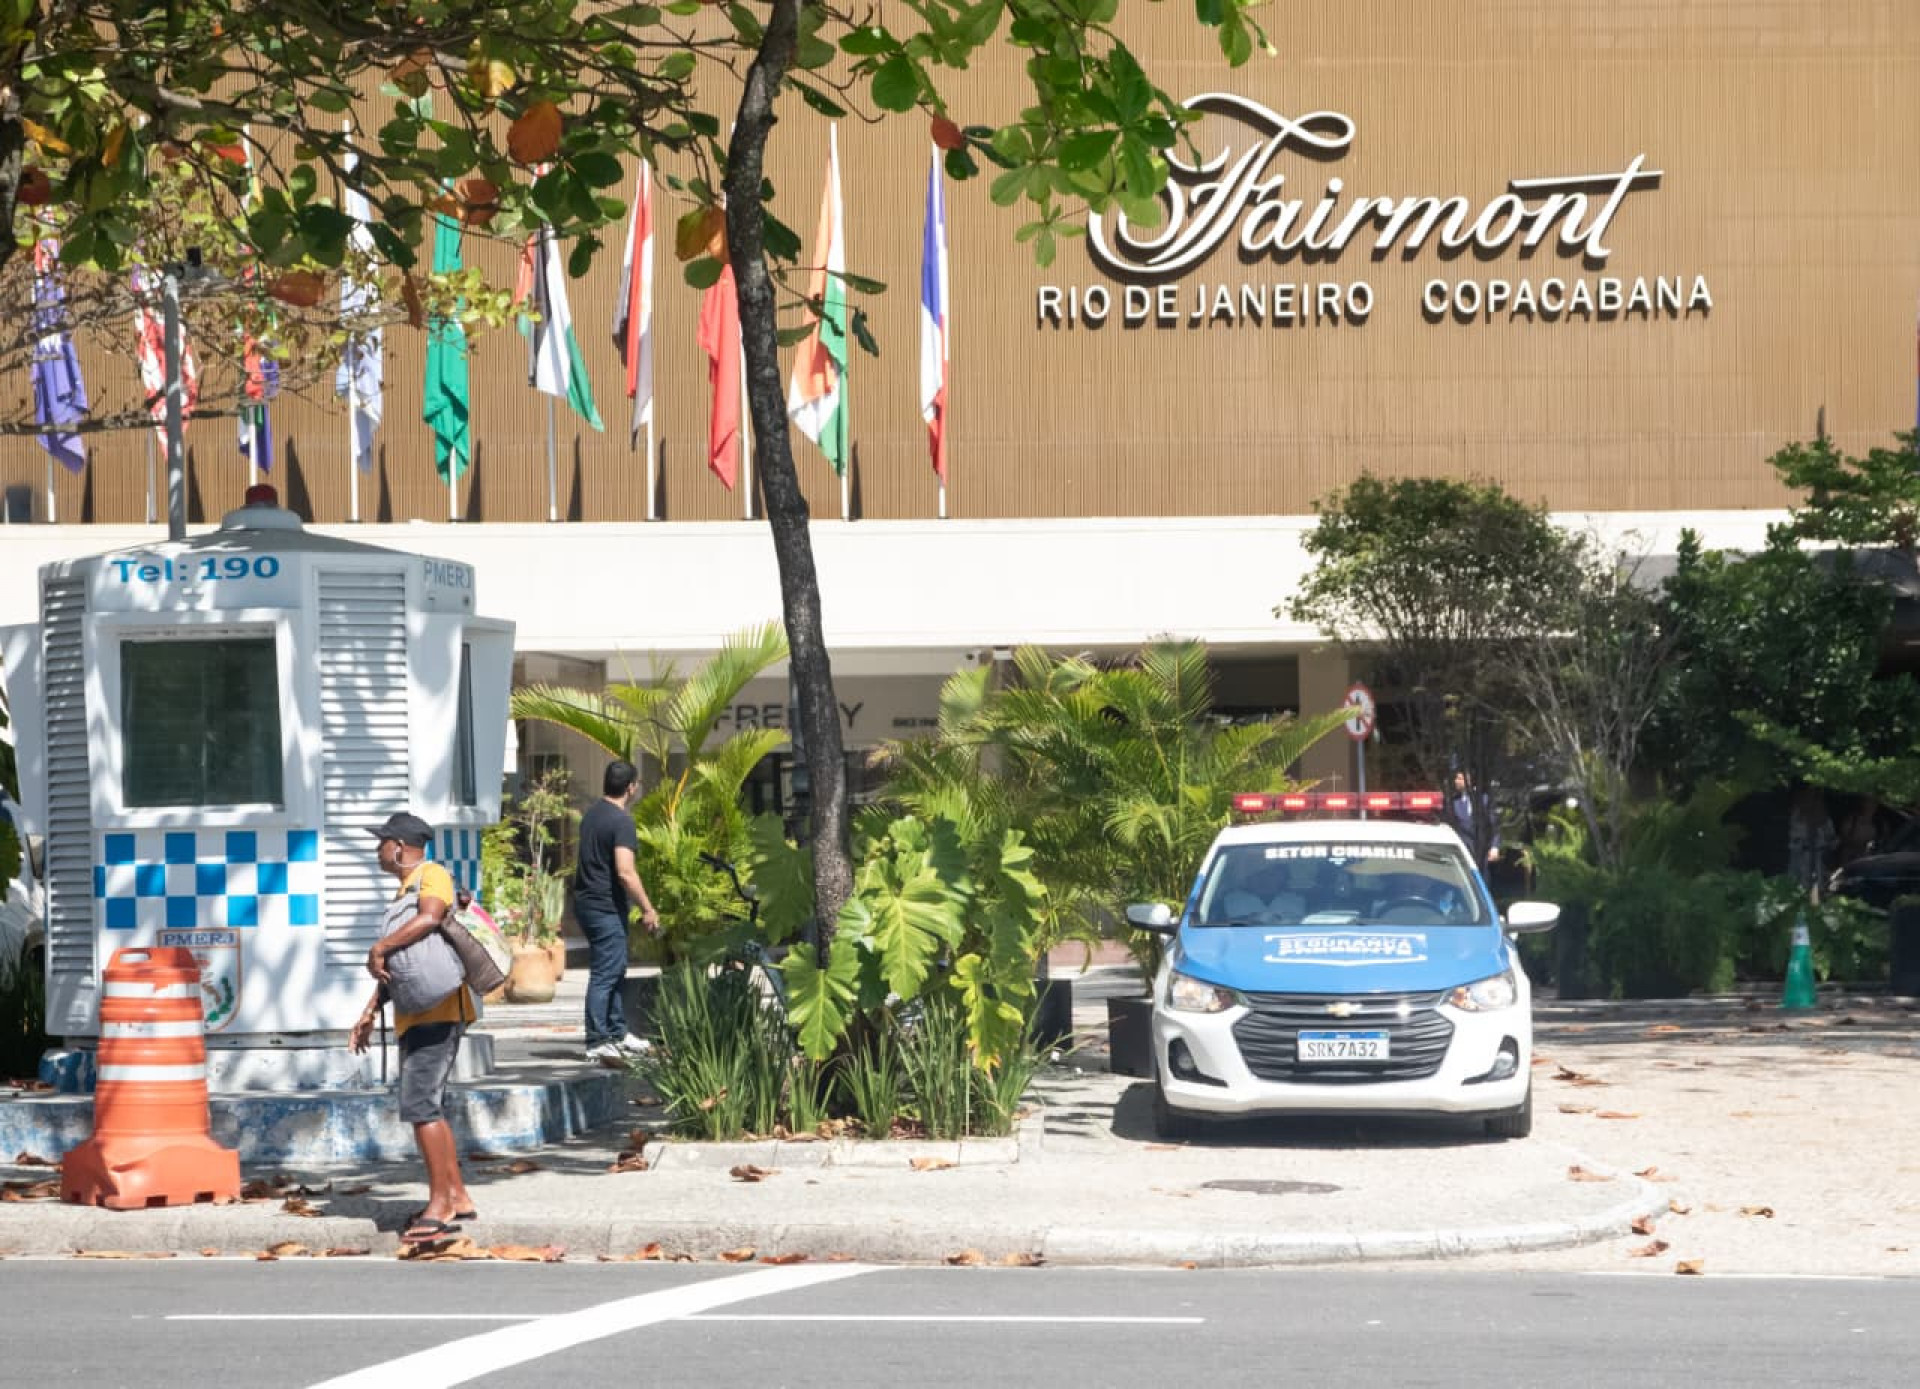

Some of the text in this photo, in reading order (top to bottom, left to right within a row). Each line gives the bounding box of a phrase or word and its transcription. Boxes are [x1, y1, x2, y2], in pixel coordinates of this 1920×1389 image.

[1088, 92, 1664, 274] Fairmont
[1038, 273, 1713, 319] RIO DE JANEIRO COPACABANA
[111, 555, 280, 583] Tel: 190
[423, 560, 472, 588] PMERJ
[713, 702, 865, 731] FREY
[1331, 845, 1416, 860] CHARLIE
[164, 932, 235, 946] PMERJ
[1307, 1041, 1378, 1057] SRK7A32
